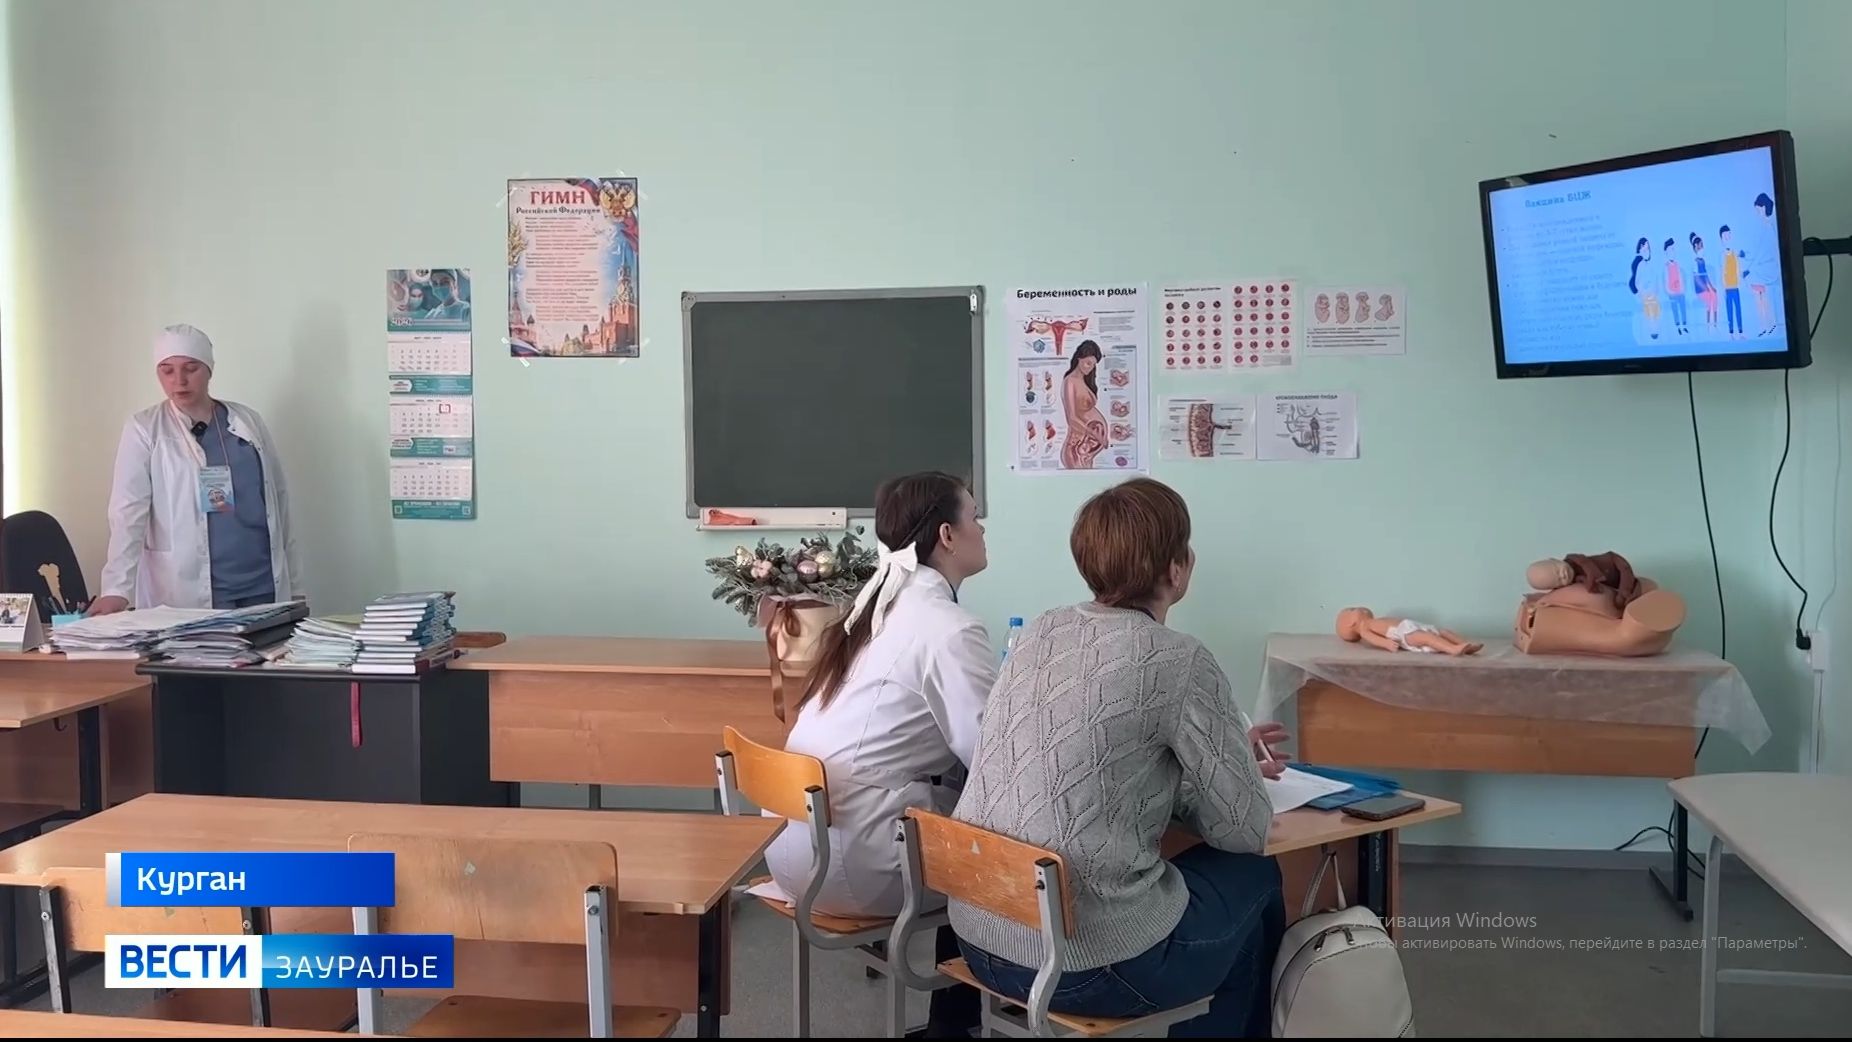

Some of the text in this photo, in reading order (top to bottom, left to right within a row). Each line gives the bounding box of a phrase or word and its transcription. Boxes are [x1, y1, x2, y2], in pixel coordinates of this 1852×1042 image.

[530, 190, 585, 205] ГИМН
[1016, 288, 1096, 300] Беременность
[1107, 287, 1137, 298] роды
